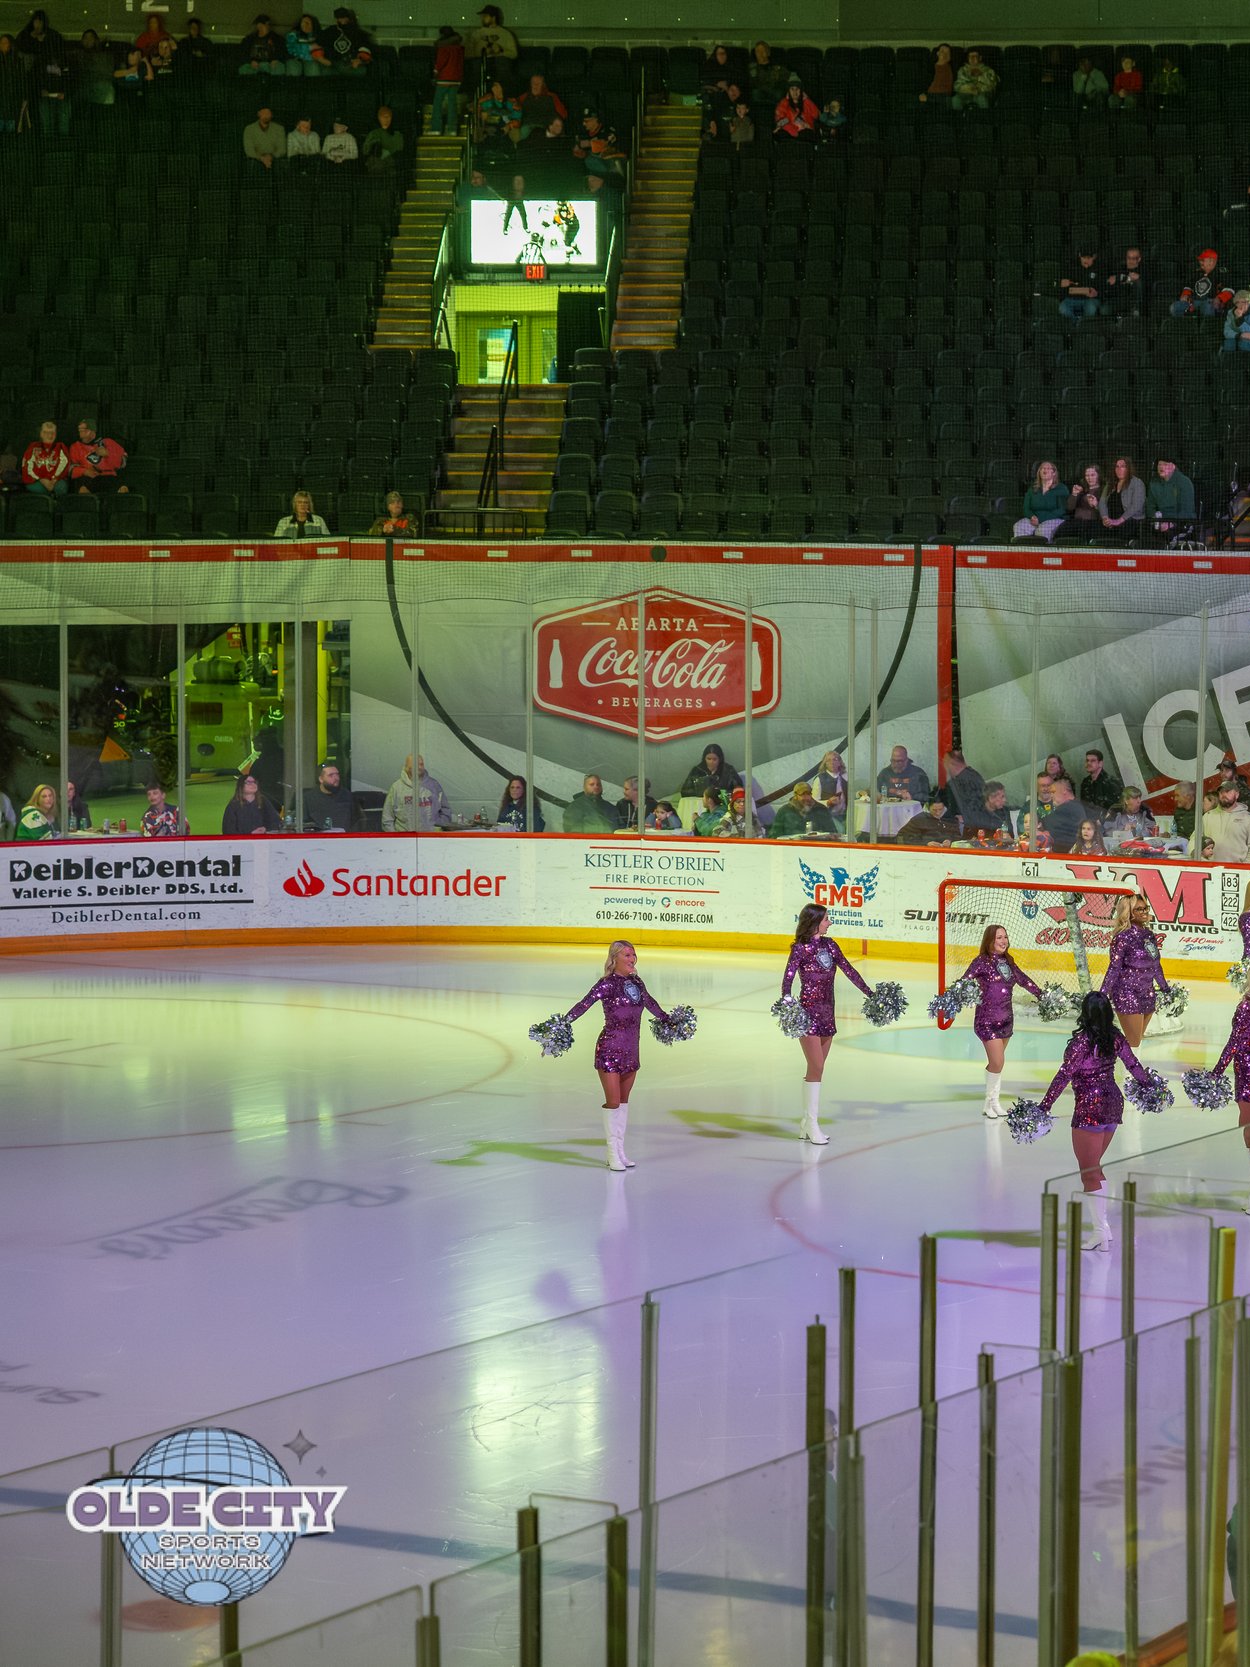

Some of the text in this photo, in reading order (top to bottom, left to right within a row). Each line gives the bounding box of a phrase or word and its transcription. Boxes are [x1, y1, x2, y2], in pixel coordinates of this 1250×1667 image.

[526, 265, 545, 279] EXIT
[577, 636, 736, 690] Coca-Cola
[611, 697, 704, 709] BEVERAGES
[9, 854, 242, 882] DeiblerDental
[584, 853, 726, 872] KISTLER O'BRIEN
[331, 868, 507, 897] Santander
[605, 874, 706, 887] FIRE PROTECTION
[1223, 877, 1238, 888] 183
[12, 882, 244, 899] Valerie S. Deibler DDS, Ltd.
[814, 884, 864, 909] CMS
[603, 896, 706, 908] powered by encore
[1223, 896, 1238, 908] 222
[51, 908, 202, 924] DeiblerDental.com
[596, 910, 714, 924] 610-266-7100 KOBFIRE.COM
[828, 908, 863, 918] struction
[867, 919, 884, 928] LLC
[1223, 916, 1238, 927] 422
[1149, 923, 1220, 935] TOWING
